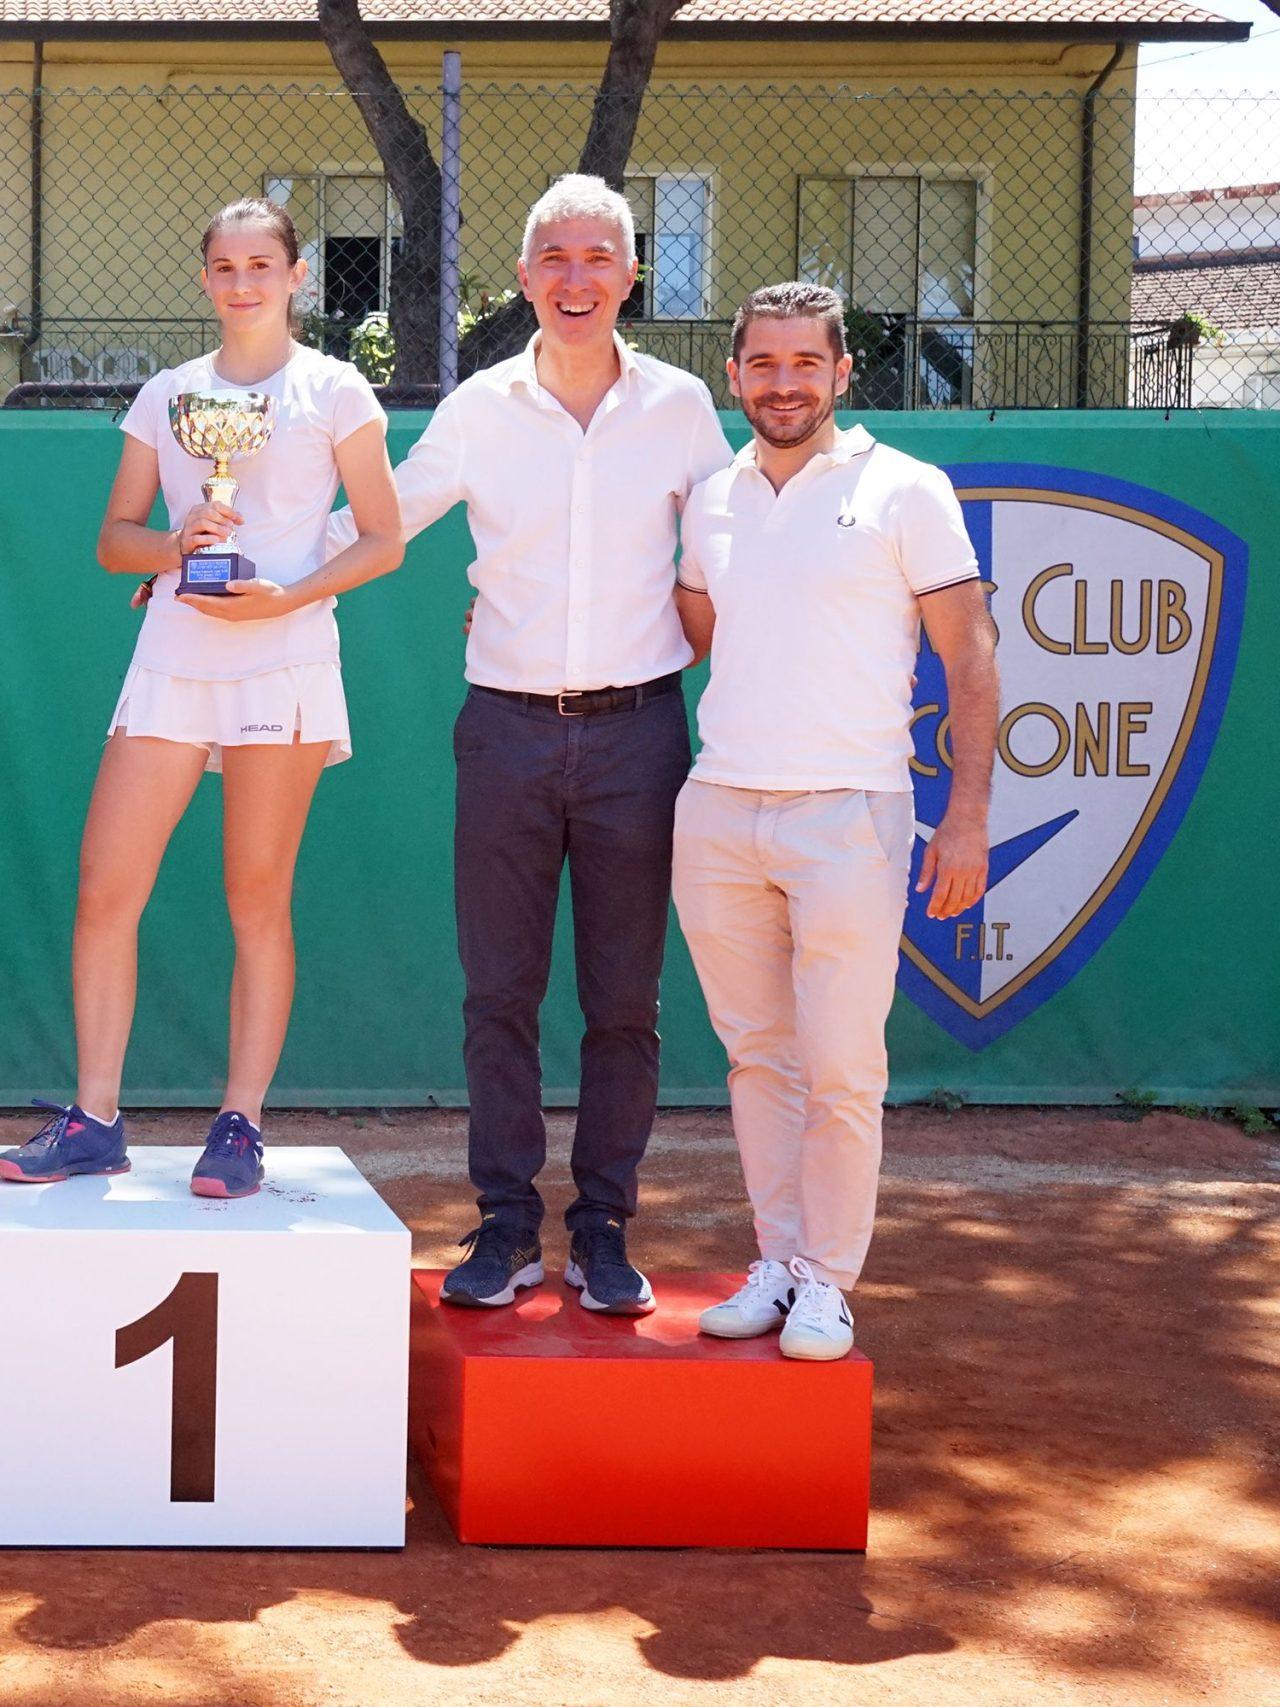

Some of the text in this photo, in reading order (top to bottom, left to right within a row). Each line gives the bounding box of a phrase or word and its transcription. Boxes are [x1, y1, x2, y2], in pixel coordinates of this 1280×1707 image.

[1022, 563, 1193, 655] CLUB
[240, 724, 283, 735] HEAD
[955, 922, 1014, 961] F.I.T.
[115, 1272, 219, 1503] 1
